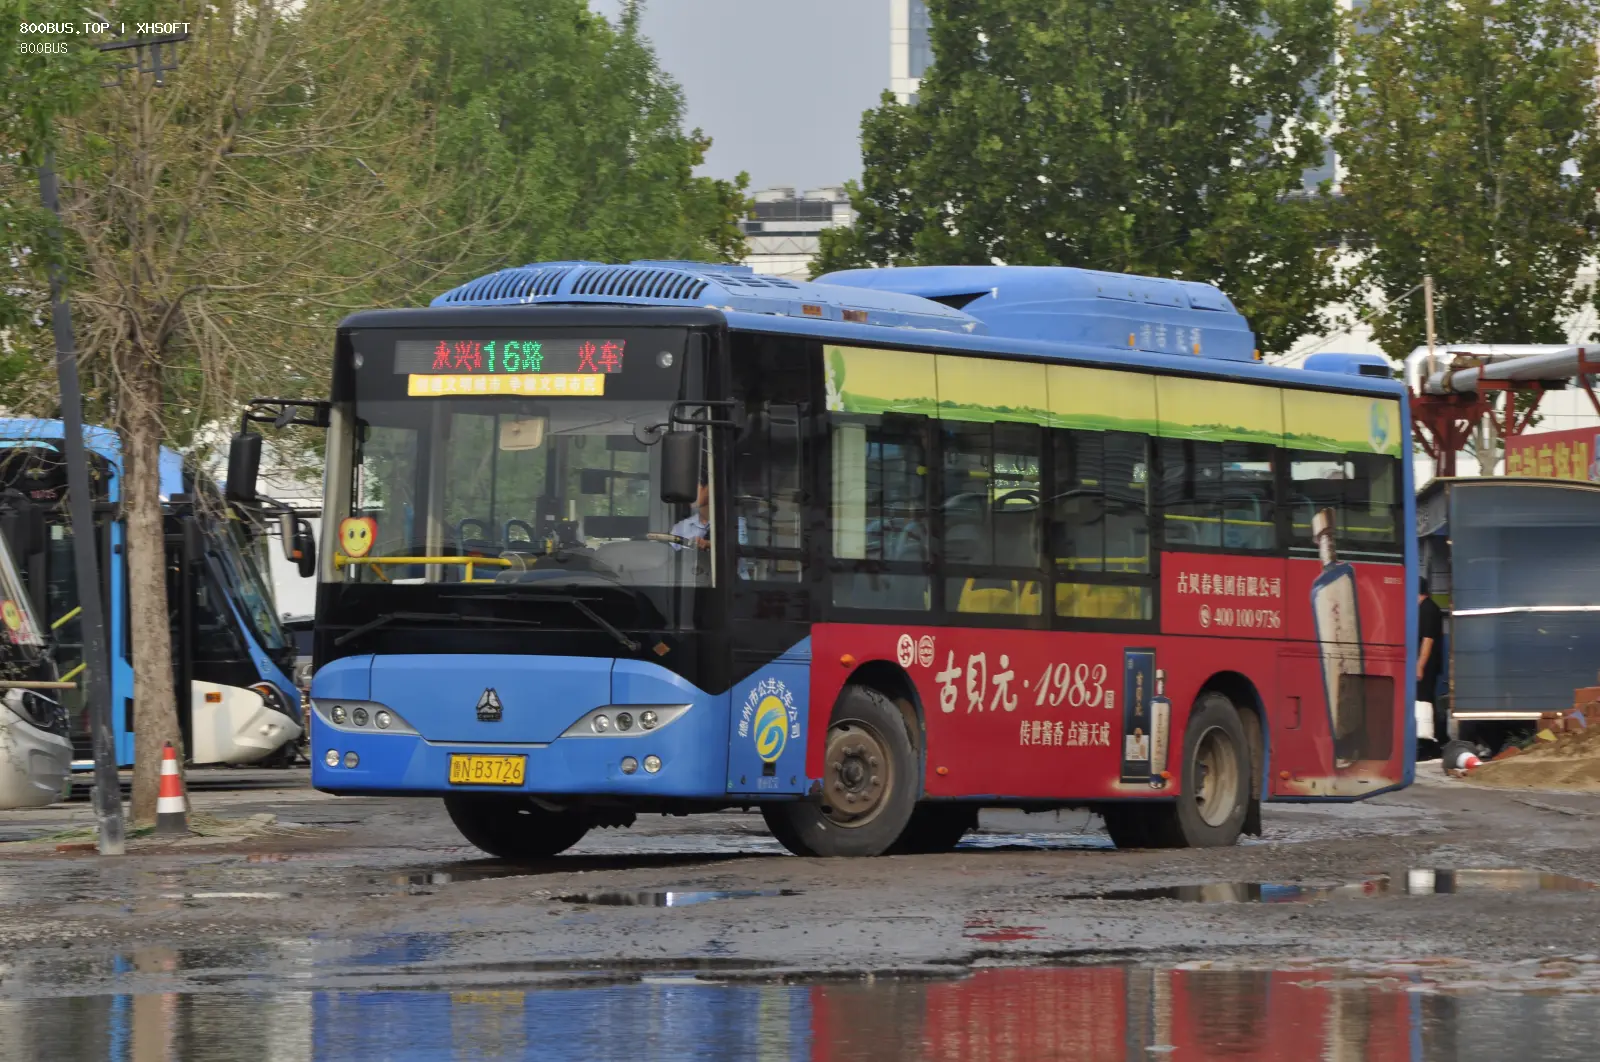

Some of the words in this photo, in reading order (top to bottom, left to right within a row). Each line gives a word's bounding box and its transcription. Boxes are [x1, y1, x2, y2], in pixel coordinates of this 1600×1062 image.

[483, 340, 544, 373] 16路
[577, 339, 626, 373] 火车
[1177, 571, 1282, 598] 古贝春集团有限公司
[1213, 607, 1234, 627] 400
[1236, 608, 1255, 627] 100
[1019, 720, 1065, 746] 传世酱香
[1066, 720, 1111, 747] 点滴天成
